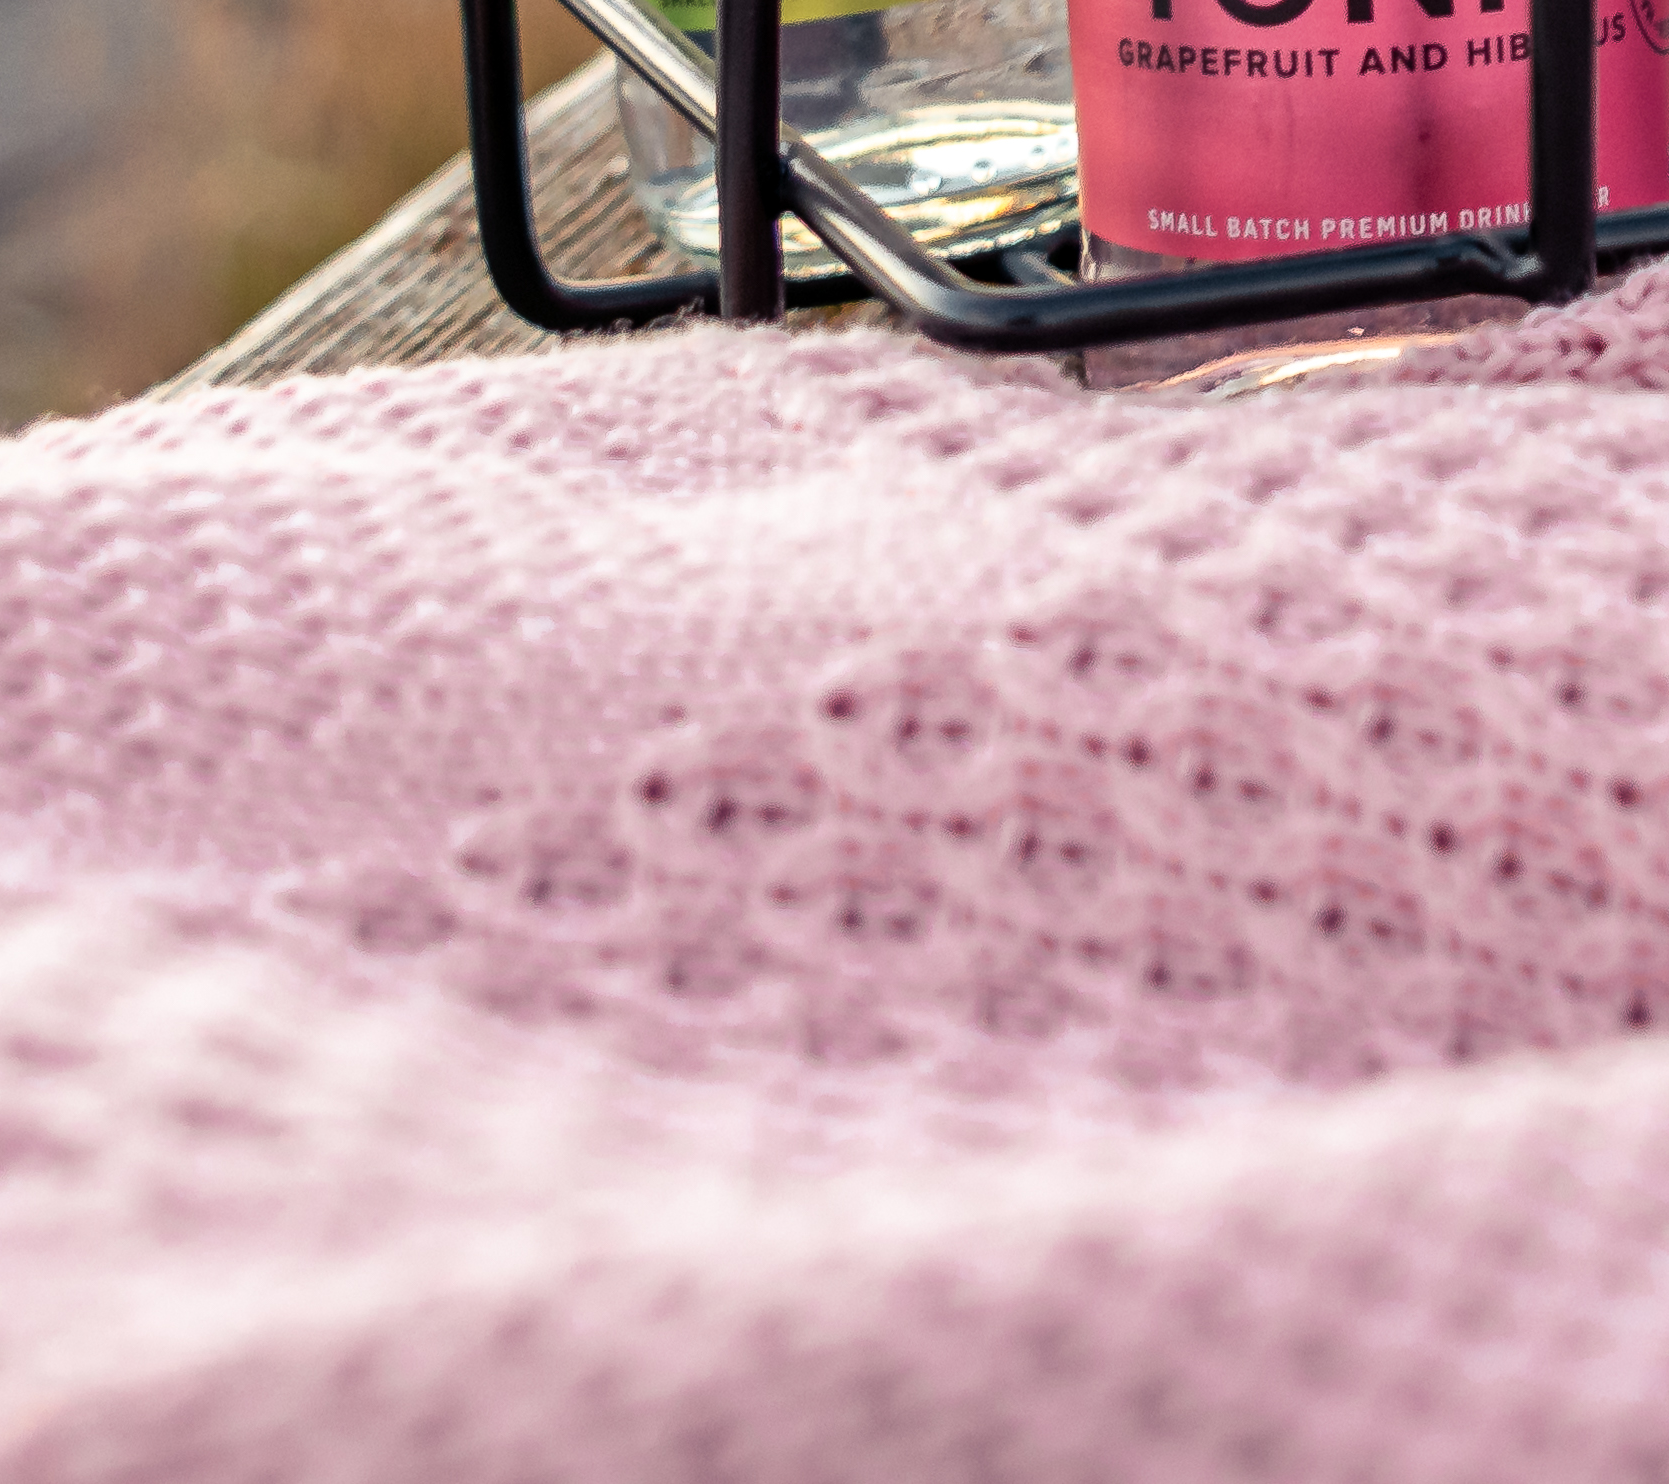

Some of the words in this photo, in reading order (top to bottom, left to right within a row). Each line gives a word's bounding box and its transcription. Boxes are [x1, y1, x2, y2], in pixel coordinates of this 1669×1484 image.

[1118, 37, 1341, 78] GRAPEFRUIT
[1358, 42, 1449, 77] AND
[1466, 13, 1628, 68] HIBUS
[1147, 208, 1218, 238] SMALL
[1226, 215, 1310, 241] BATCH
[1321, 210, 1448, 241] PREMIUM
